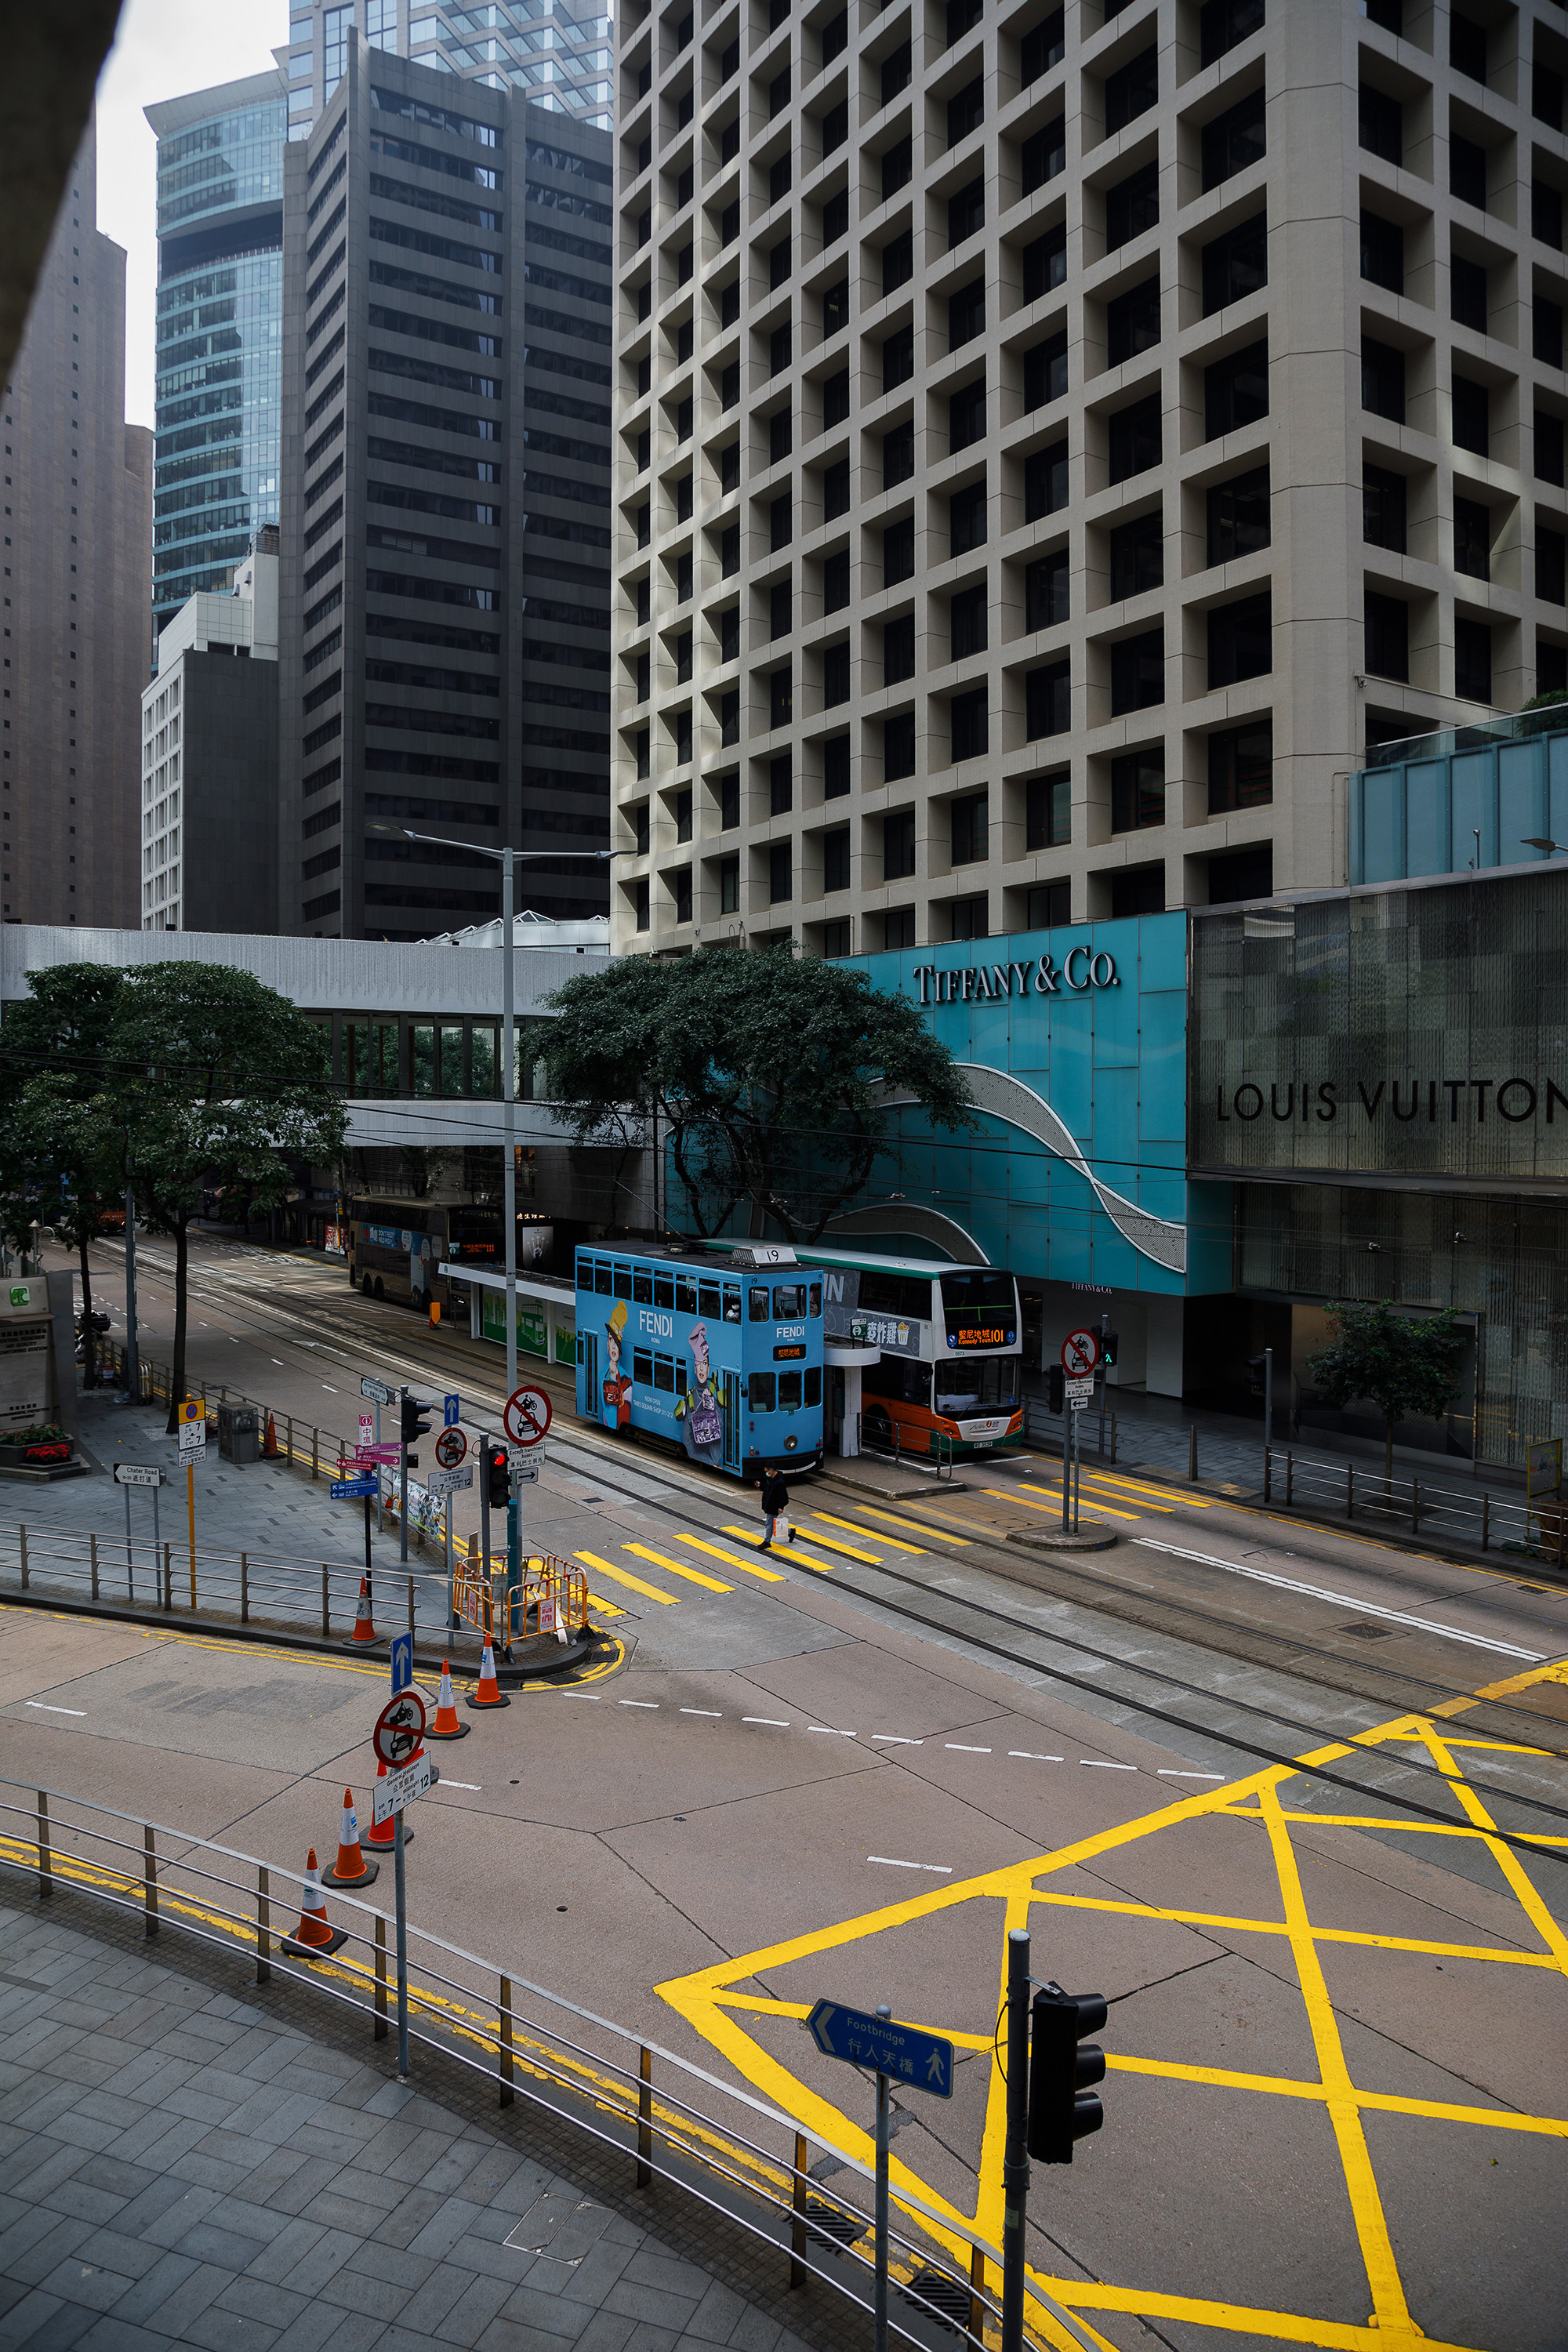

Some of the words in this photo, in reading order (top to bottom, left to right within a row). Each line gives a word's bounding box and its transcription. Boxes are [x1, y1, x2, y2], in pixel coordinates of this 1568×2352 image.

[1218, 1082, 1337, 1122] LOUIS
[486, 1243, 495, 1253] 111
[767, 1250, 779, 1261] 19
[639, 1309, 673, 1338] FENDI
[776, 1326, 805, 1338] FENDI
[958, 1329, 990, 1340] 堅尼地城
[991, 1329, 1004, 1343] 101
[362, 1428, 372, 1444] 中環
[132, 1474, 152, 1483] 遮打道
[387, 1773, 402, 1787] General
[402, 1762, 419, 1777] Holidays
[420, 1774, 429, 1789] 12
[403, 1779, 419, 1794] midnight
[388, 1798, 394, 1812] 7
[848, 2016, 906, 2046] Footbridge
[848, 2038, 914, 2076] 行人天橋
